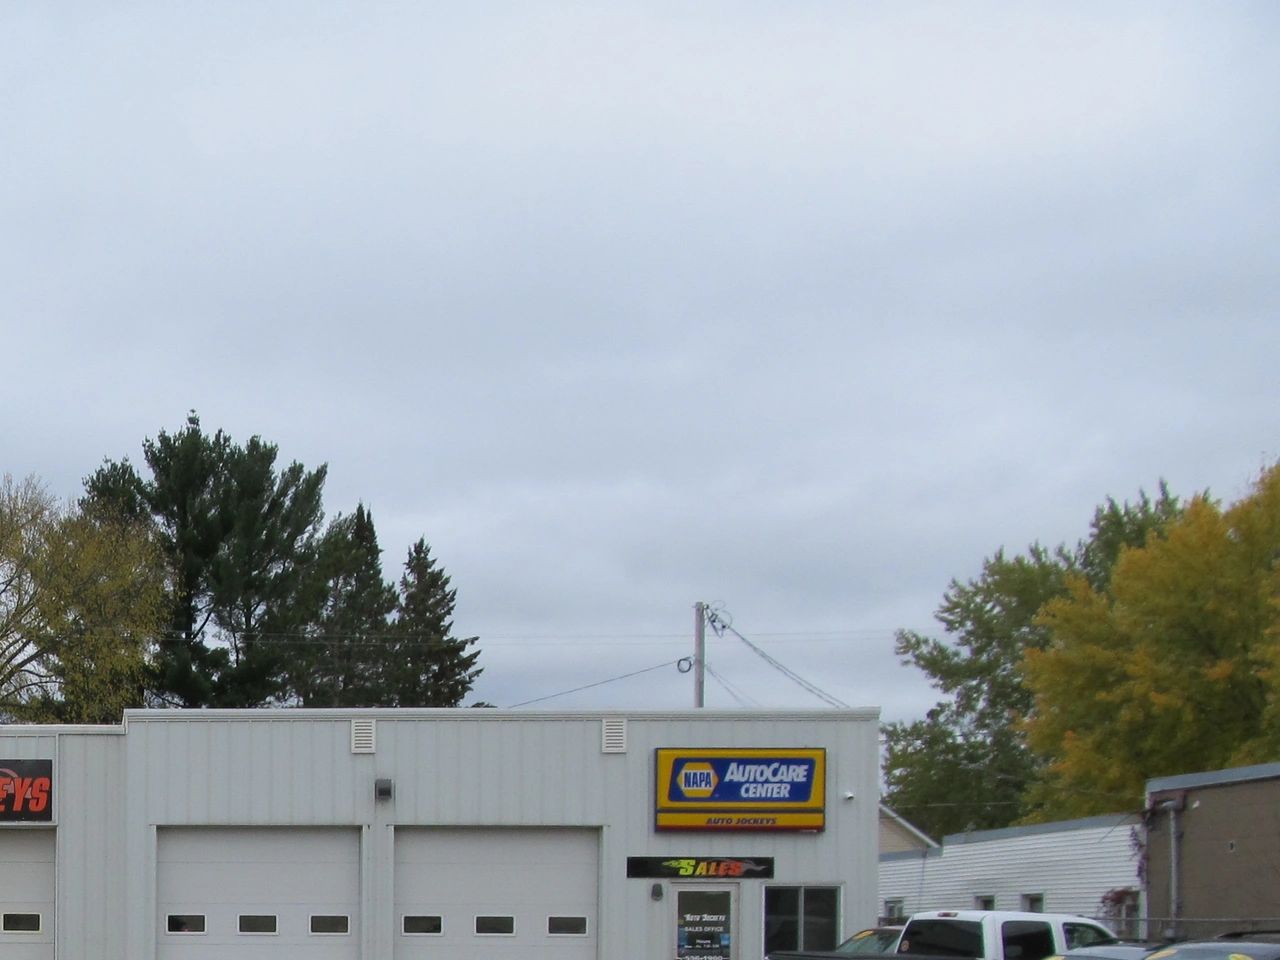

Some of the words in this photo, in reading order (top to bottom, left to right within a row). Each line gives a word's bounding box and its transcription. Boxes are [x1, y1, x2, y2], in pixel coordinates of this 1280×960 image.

[683, 771, 713, 788] NAPA
[740, 783, 791, 798] CENTER
[706, 817, 733, 825] AUTO
[735, 817, 778, 825] JOCKEYS
[677, 859, 744, 876] SALES
